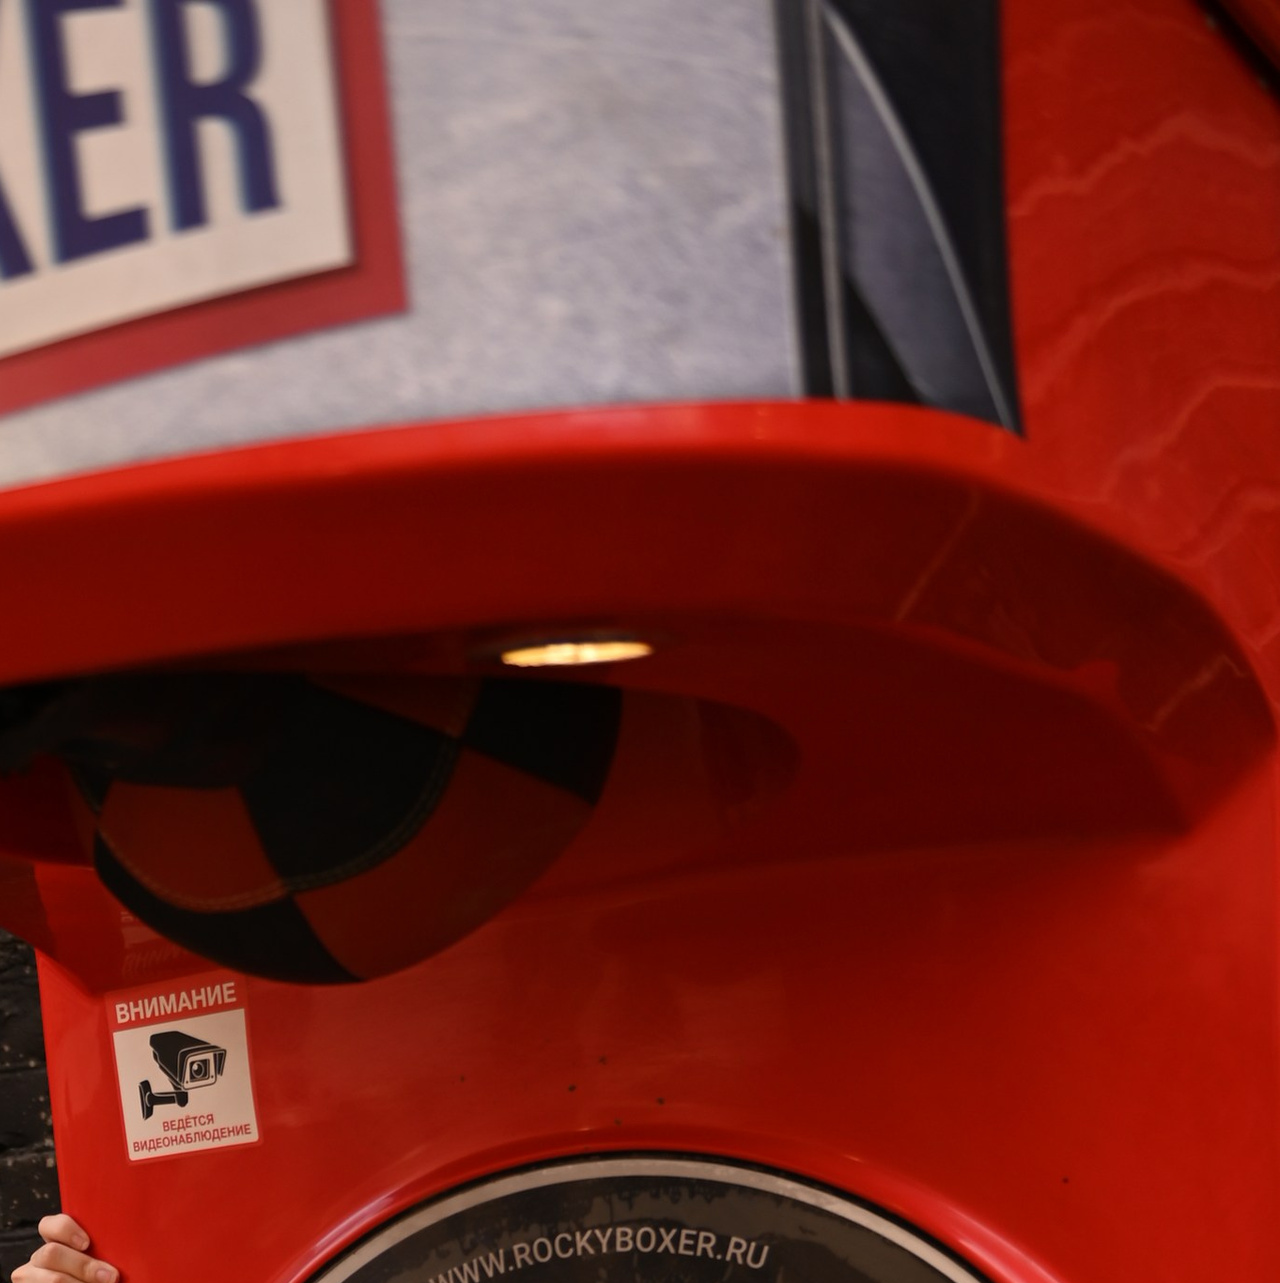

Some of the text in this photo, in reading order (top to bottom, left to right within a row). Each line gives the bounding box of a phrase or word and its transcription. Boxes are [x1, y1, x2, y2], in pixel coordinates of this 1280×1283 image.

[115, 982, 237, 1024] ВНИМАНИЕ
[162, 1113, 215, 1132] ВЕДЁТСЯ
[133, 1124, 252, 1153] ВИДЕОНАБЛЮДЕНИЕ
